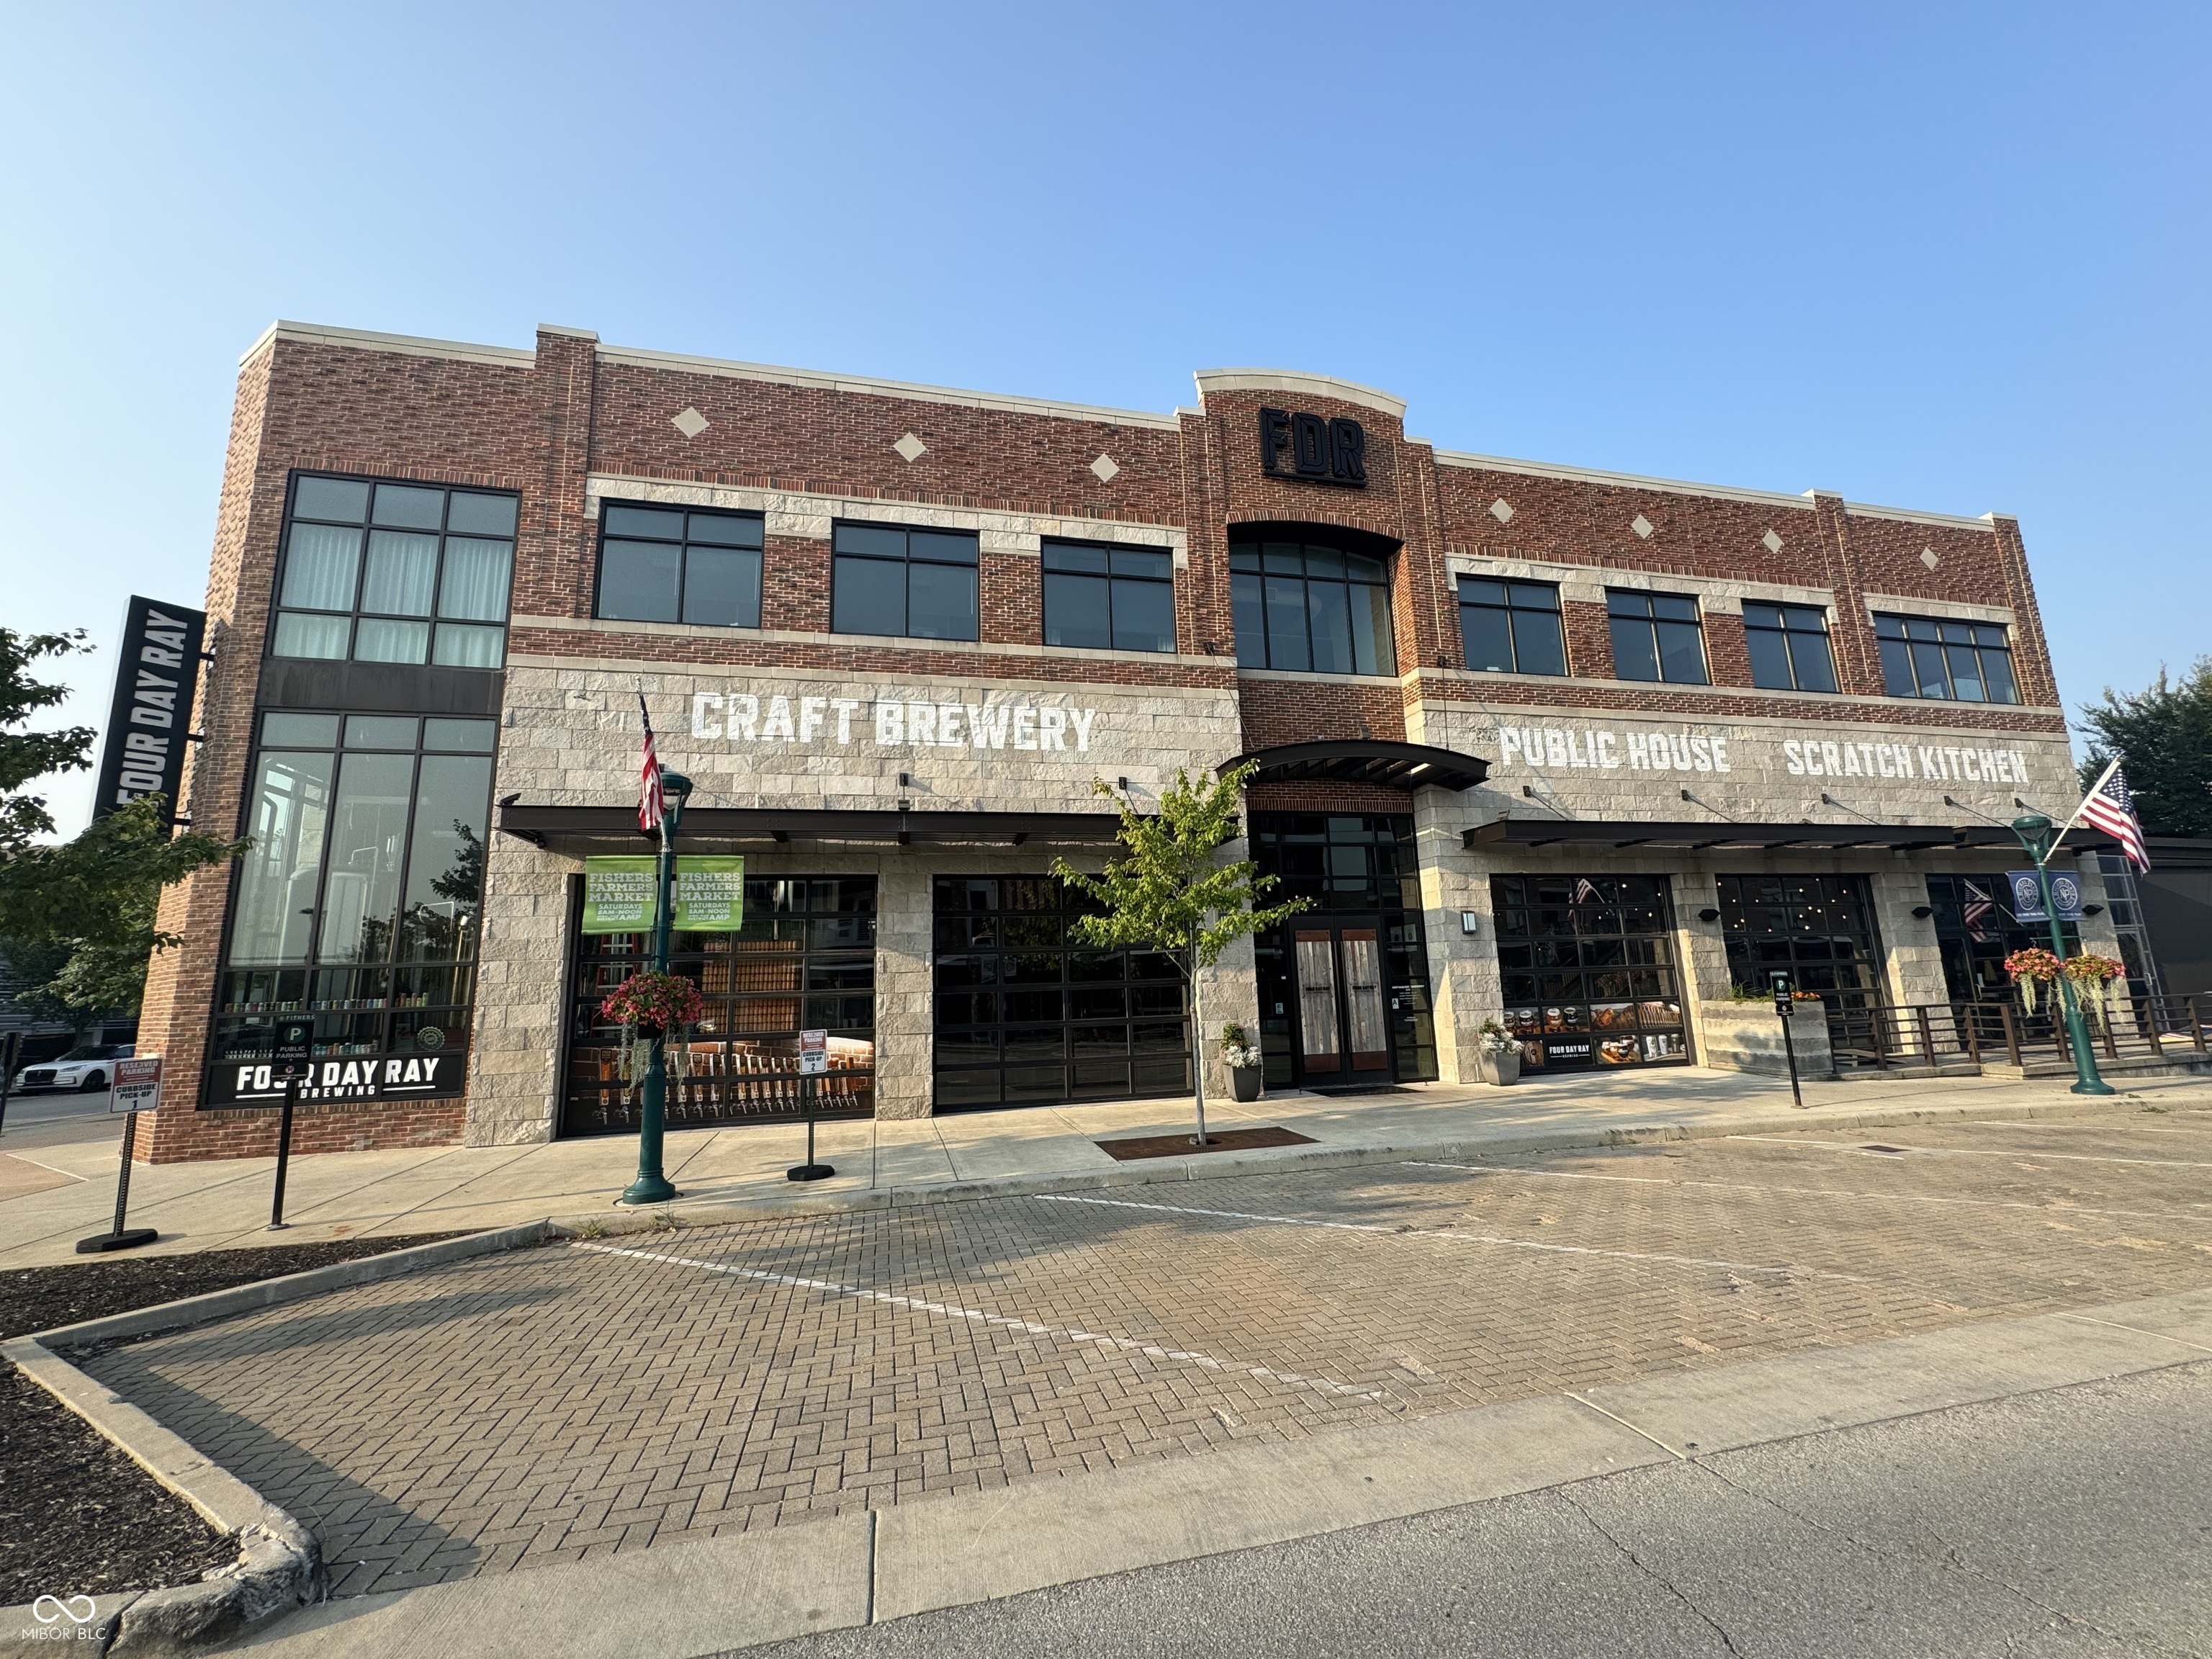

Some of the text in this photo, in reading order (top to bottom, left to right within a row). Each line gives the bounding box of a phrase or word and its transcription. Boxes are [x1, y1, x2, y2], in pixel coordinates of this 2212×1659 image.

[1259, 408, 1367, 480] FDR
[140, 608, 189, 669] RAY
[130, 669, 179, 729] DAY
[691, 692, 1096, 752] CRAFT BREWERY
[1499, 727, 1731, 773] PUBLIC HOUSE
[1784, 739, 2028, 783] SCRATCH KITCHEN
[589, 873, 653, 882] FISHERS
[680, 872, 741, 881] FISHERS
[588, 892, 654, 902] MARKET
[680, 891, 741, 901] MARKET
[1779, 980, 1784, 989] P
[289, 1028, 302, 1041] P
[1549, 1046, 1565, 1054] FOUR
[120, 1061, 158, 1069] RESERVED
[322, 1061, 378, 1086] DAY
[385, 1058, 439, 1083] RAY
[116, 1084, 156, 1093] CURBSIDE
[300, 1085, 375, 1099] BREWING
[120, 1091, 152, 1100] PICK-UP
[132, 1100, 138, 1110] 1
